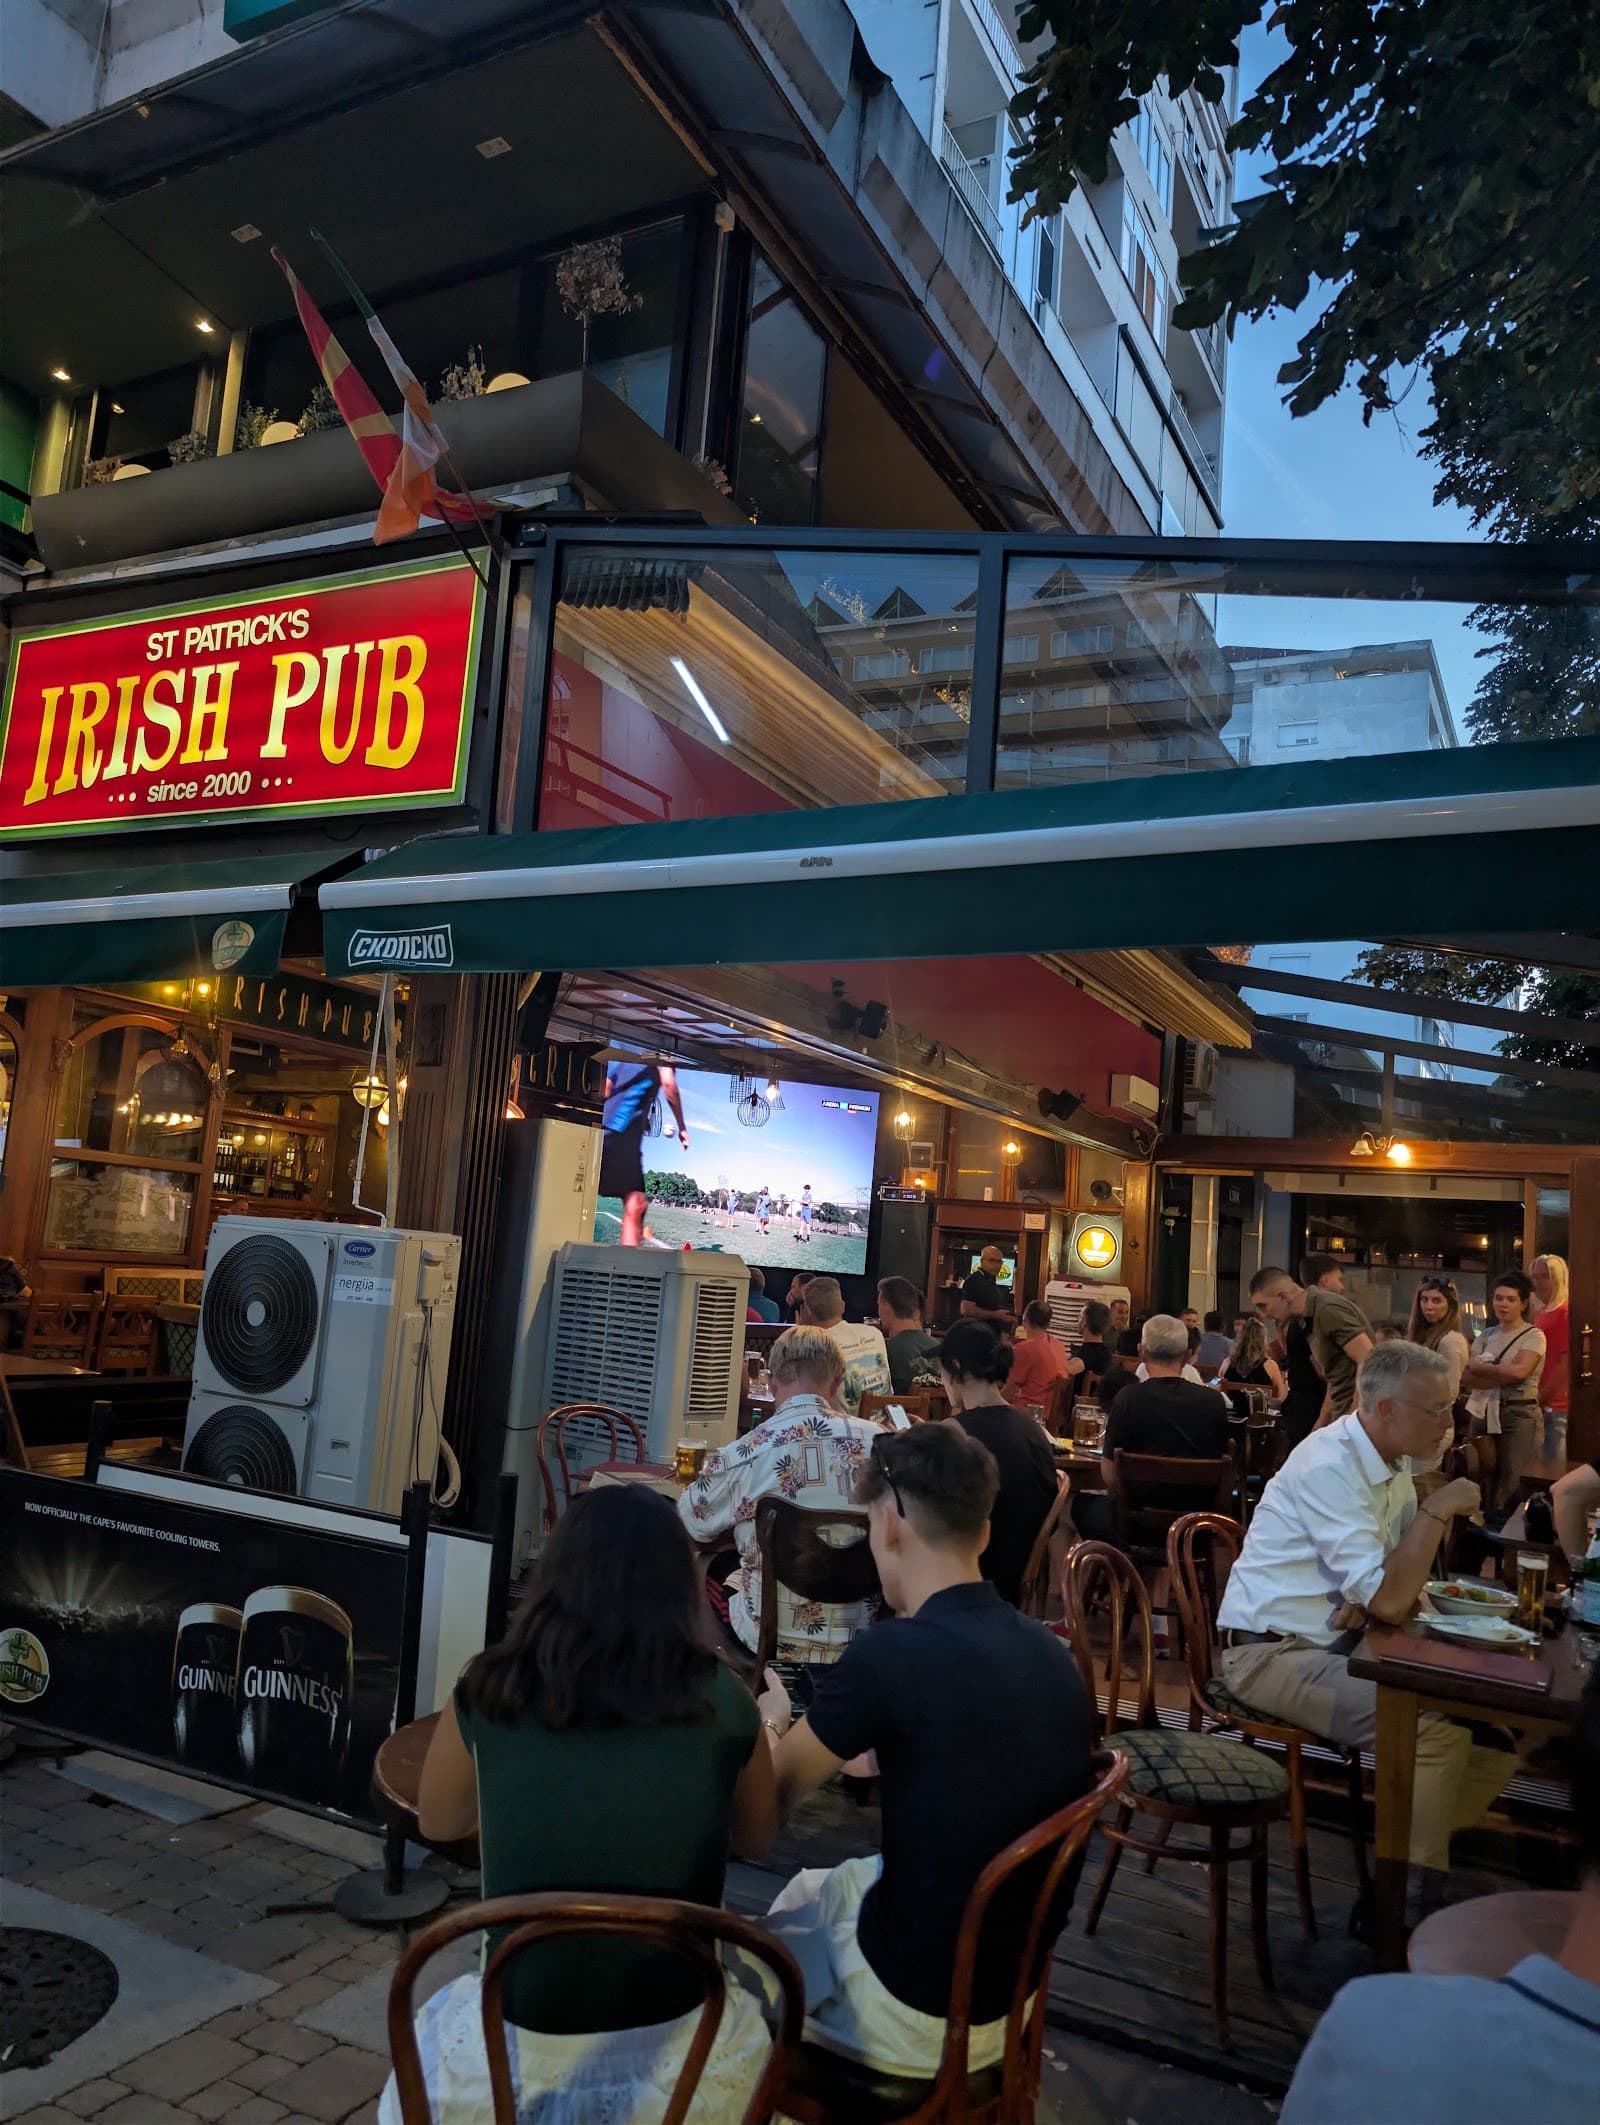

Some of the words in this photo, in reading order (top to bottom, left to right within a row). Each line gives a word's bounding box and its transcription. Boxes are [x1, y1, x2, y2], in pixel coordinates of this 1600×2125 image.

[146, 630, 179, 661] ST
[184, 608, 310, 656] PATRICK'S
[23, 661, 240, 806] IRISH
[260, 635, 428, 770] PUB
[147, 779, 198, 802] since
[202, 771, 251, 797] 2000
[348, 1243, 372, 1253] Carrier
[24, 1501, 42, 1513] NOW
[42, 1506, 78, 1521] OFFICIALLY
[79, 1513, 92, 1524] THE
[92, 1515, 116, 1529] CAPE'S
[116, 1521, 155, 1538] FAVOURITE
[155, 1529, 188, 1545] COOLING
[244, 1666, 343, 1718] GUINNESS
